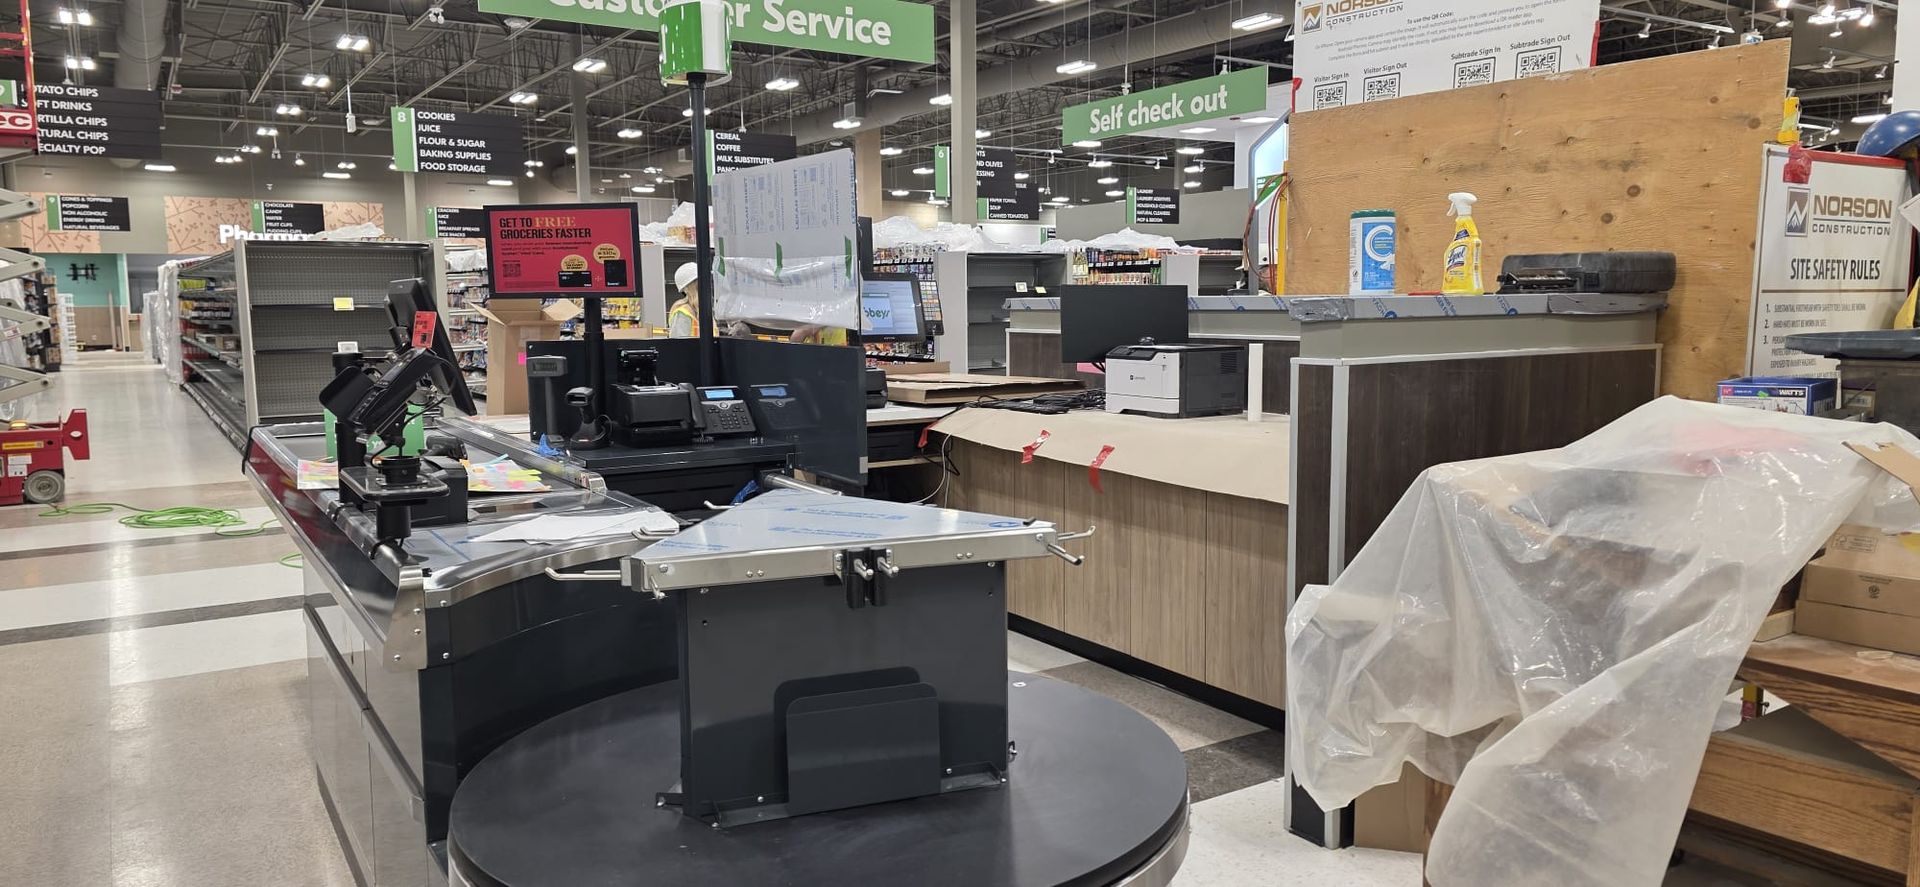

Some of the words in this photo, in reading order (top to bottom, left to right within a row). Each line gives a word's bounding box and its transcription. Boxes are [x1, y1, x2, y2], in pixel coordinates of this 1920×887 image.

[1326, 0, 1395, 16] NORS
[1326, 4, 1404, 26] CONSTRUCTION
[763, 0, 892, 45] Service
[1510, 39, 1540, 50] Subtrade
[1540, 37, 1556, 46] Sign
[1557, 34, 1571, 42] Out
[1451, 51, 1478, 60] Subtrade
[1479, 48, 1494, 56] Sign
[1364, 66, 1382, 75] Visitor
[1382, 64, 1396, 73] Sign
[1396, 62, 1408, 70] Out
[1314, 75, 1331, 83] Visitor
[1332, 73, 1341, 82] Sign
[66, 86, 99, 98] CHIPS
[21, 98, 50, 109] SFT
[52, 102, 93, 112] DRINKS
[1089, 103, 1124, 134] Self
[1128, 92, 1184, 127] check
[1190, 84, 1228, 115] out
[38, 114, 74, 125] RTILLA
[76, 116, 108, 127] CHIPS
[398, 112, 406, 122] 8
[417, 111, 456, 121] COOKIES
[418, 124, 441, 132] JUICE
[37, 128, 75, 139] TURAL
[77, 130, 109, 141] CHIPS
[716, 132, 741, 140] CEREAL
[38, 143, 81, 154] ECIALTY
[84, 144, 106, 154] POP
[419, 137, 447, 146] FLOUR
[448, 138, 455, 146] &
[456, 139, 486, 148] SUGAR
[716, 144, 741, 152] COFFEE
[420, 150, 454, 158] BAKING
[456, 150, 492, 160] SUPPLIES
[938, 150, 944, 158] 6
[420, 162, 446, 171] FOOD
[448, 163, 486, 173] STORAGE
[976, 170, 995, 178] ESSING
[1812, 194, 1892, 219] NORSON
[499, 218, 516, 228] GET
[520, 218, 532, 228] TO
[534, 216, 576, 228] FREE
[219, 224, 311, 244] Pharma
[500, 228, 553, 240] GROCERIES
[556, 228, 592, 238] FASTER
[1812, 224, 1891, 236] CONSTRUCTION
[1790, 258, 1811, 280] SITE
[1813, 258, 1848, 280] SAFETY
[1850, 260, 1881, 280] RULES
[864, 307, 890, 320] obeys
[1766, 304, 1771, 313] 1.
[1764, 319, 1770, 329] 2.
[1763, 336, 1769, 344] 3.
